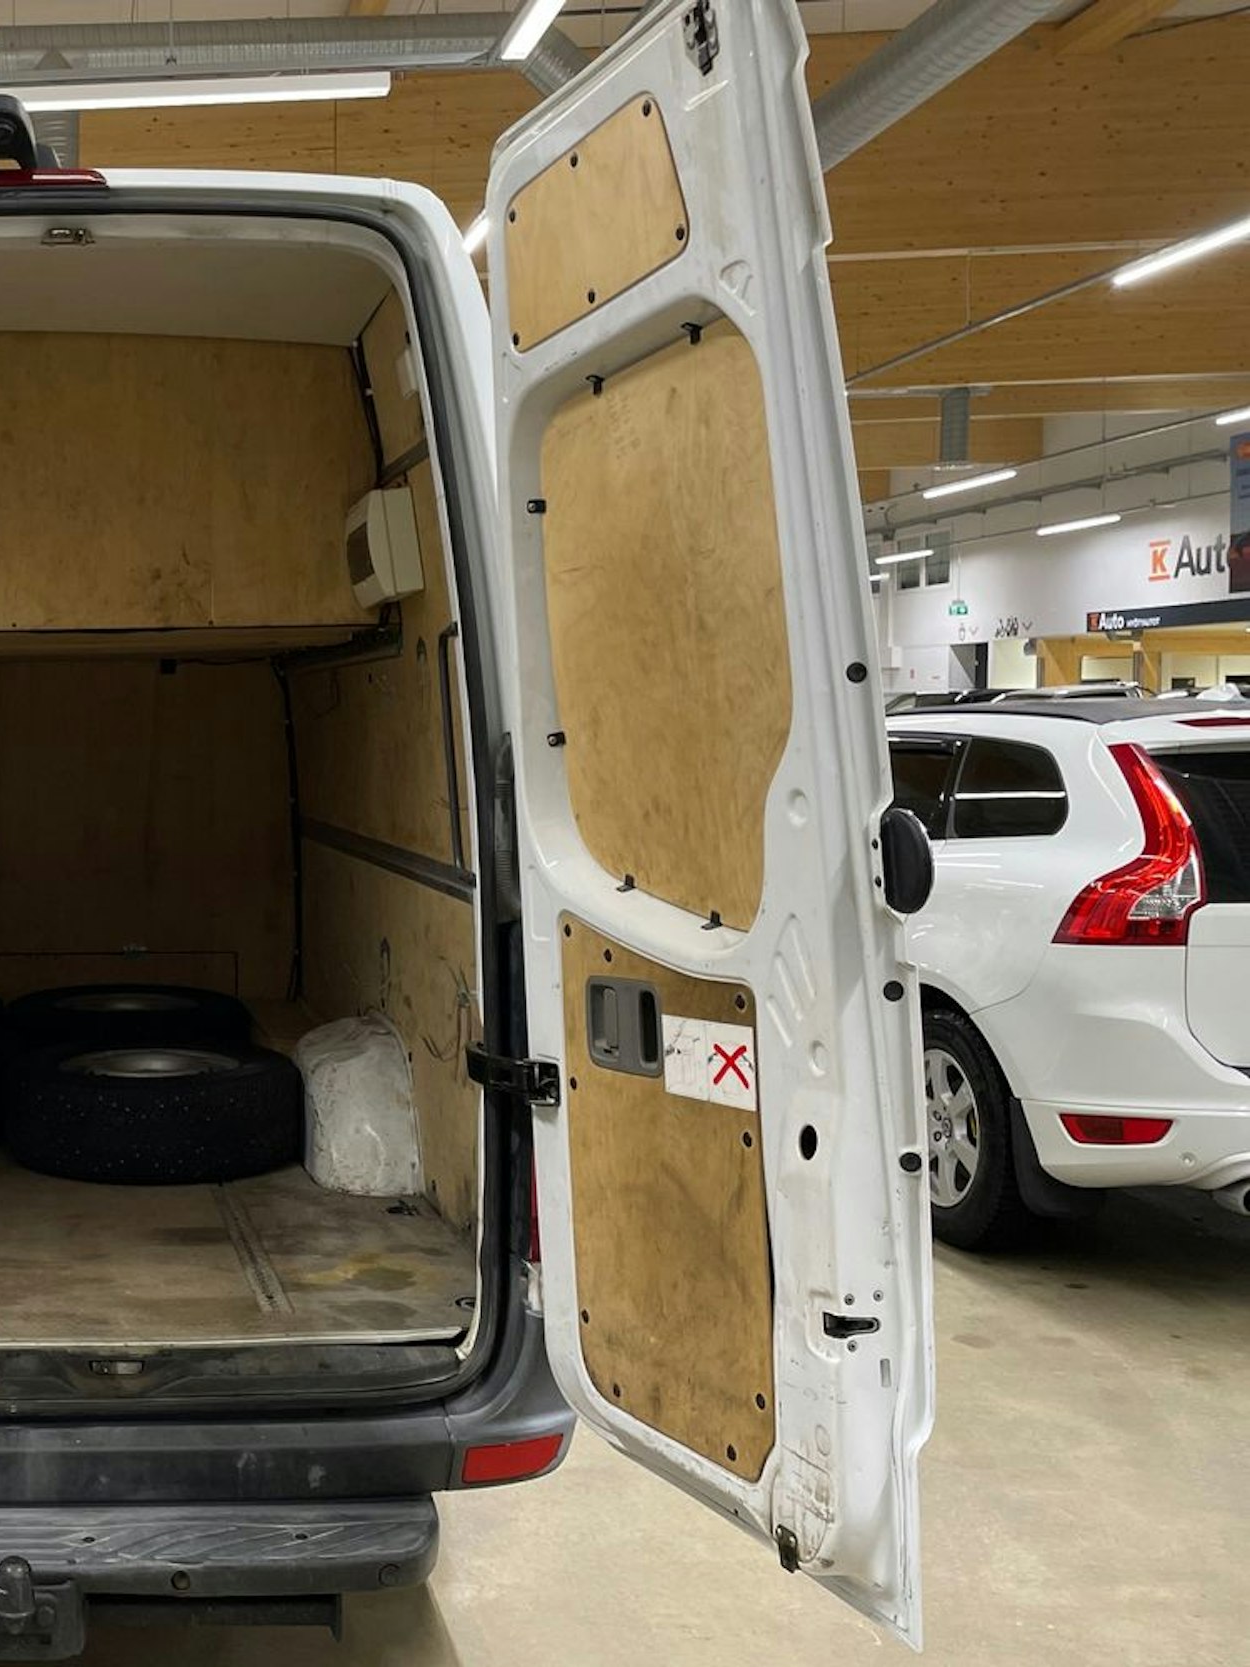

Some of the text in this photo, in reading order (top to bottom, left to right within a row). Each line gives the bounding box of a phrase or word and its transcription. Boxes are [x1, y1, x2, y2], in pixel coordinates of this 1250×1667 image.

[1150, 533, 1230, 580] K Aut
[1098, 613, 1125, 630] Auto
